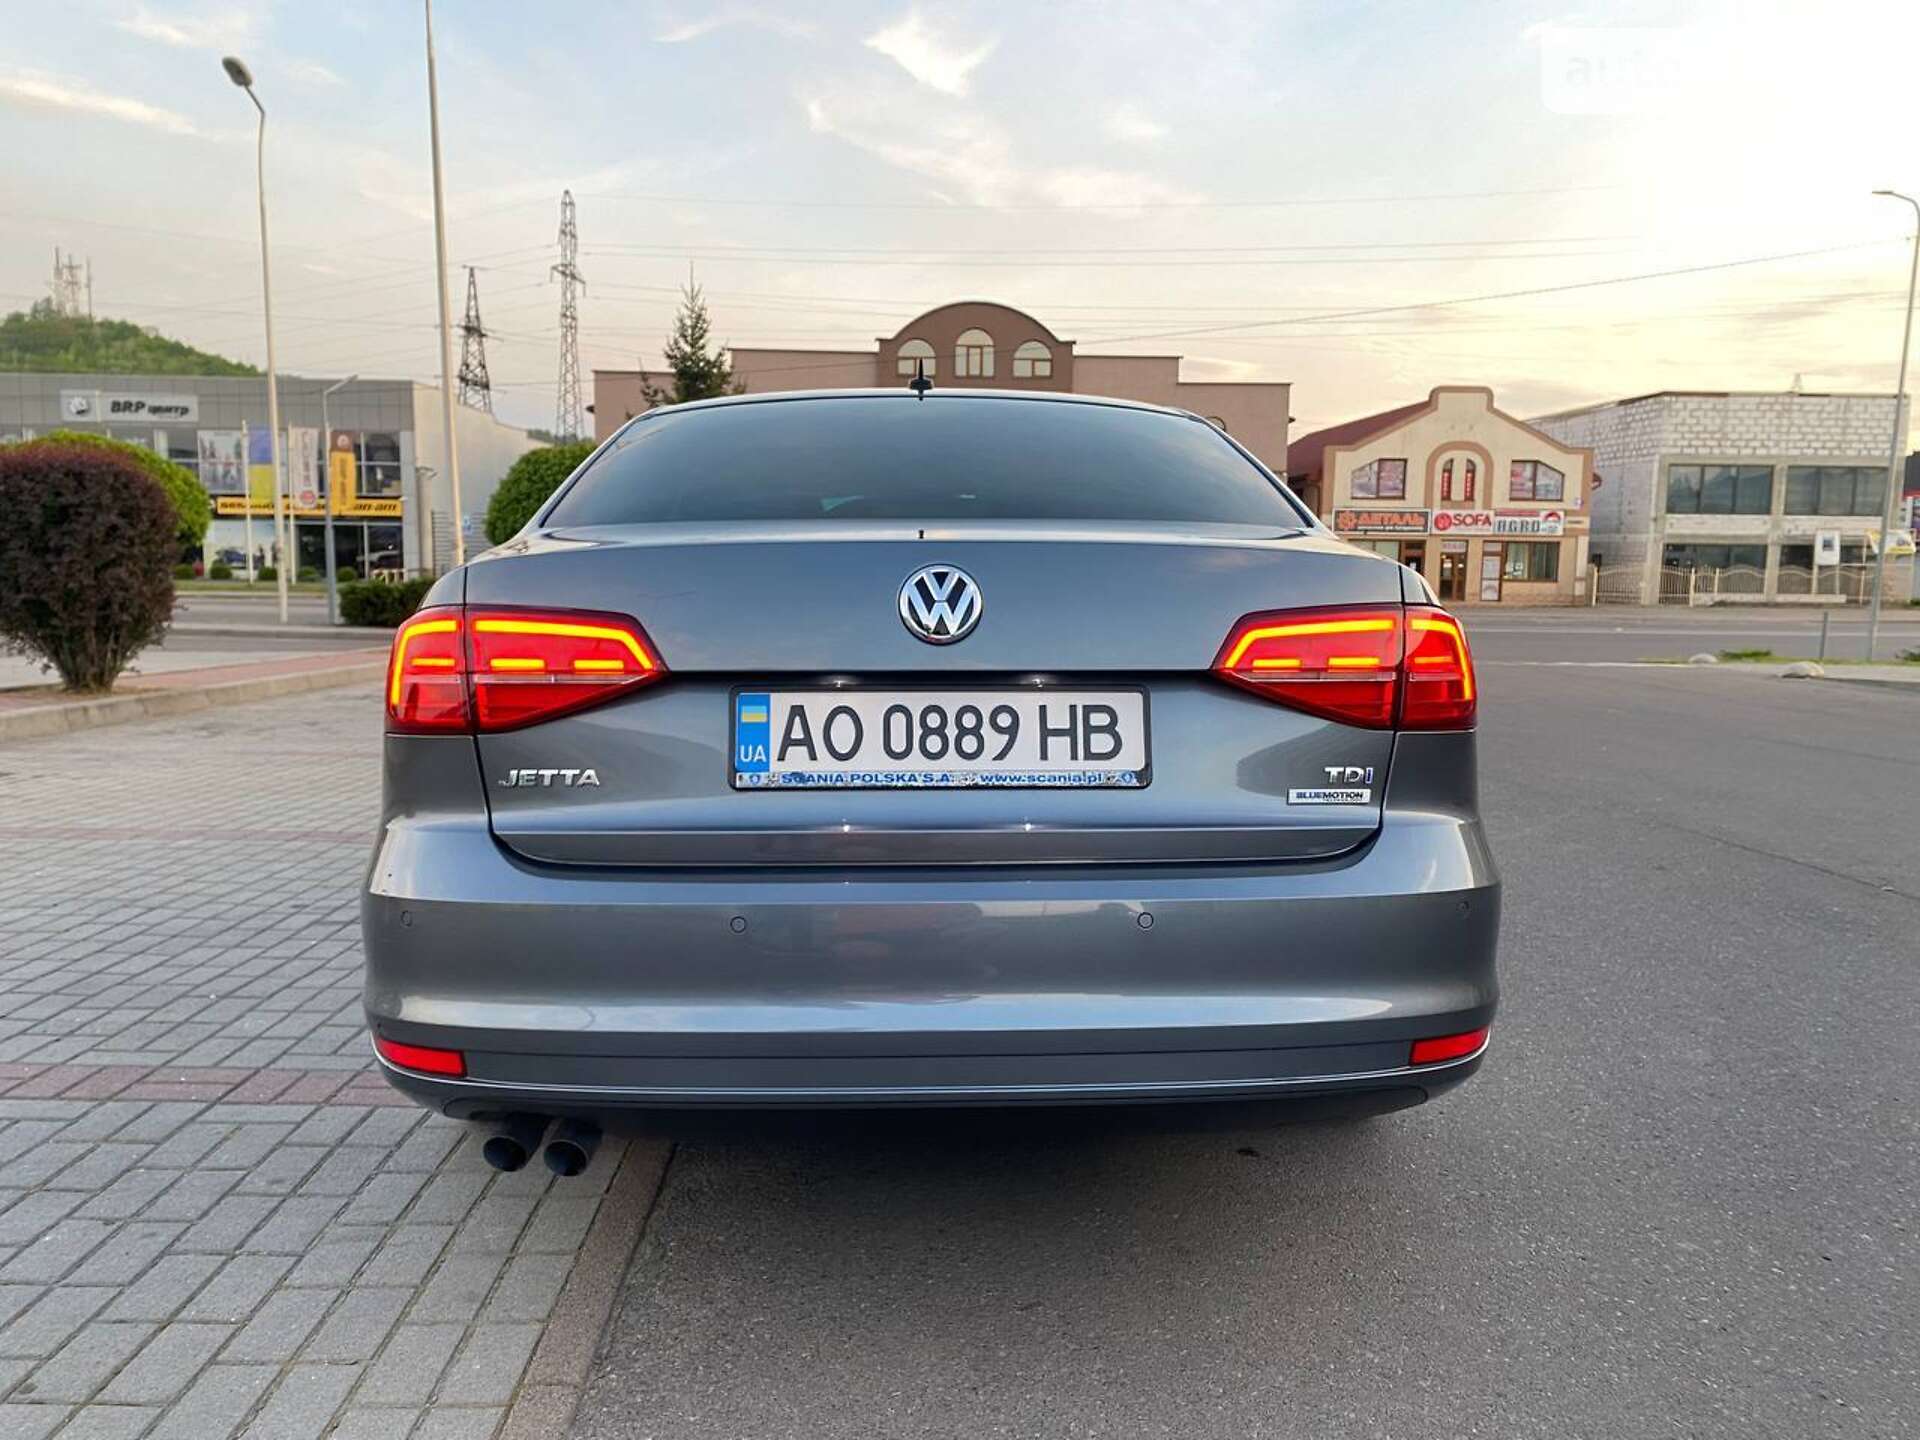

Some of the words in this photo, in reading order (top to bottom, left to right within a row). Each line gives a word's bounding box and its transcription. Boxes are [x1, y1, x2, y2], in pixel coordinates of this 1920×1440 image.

[110, 401, 146, 413] BRP
[1453, 513, 1492, 526] SOFA
[777, 704, 863, 762] AO
[882, 704, 1020, 761] 0889
[1038, 704, 1123, 761] HB
[739, 745, 767, 762] UA
[499, 769, 600, 786] JETTA
[850, 772, 917, 783] POLSKA
[1324, 766, 1374, 784] TDI
[1296, 791, 1364, 800] BLUEMOTION
